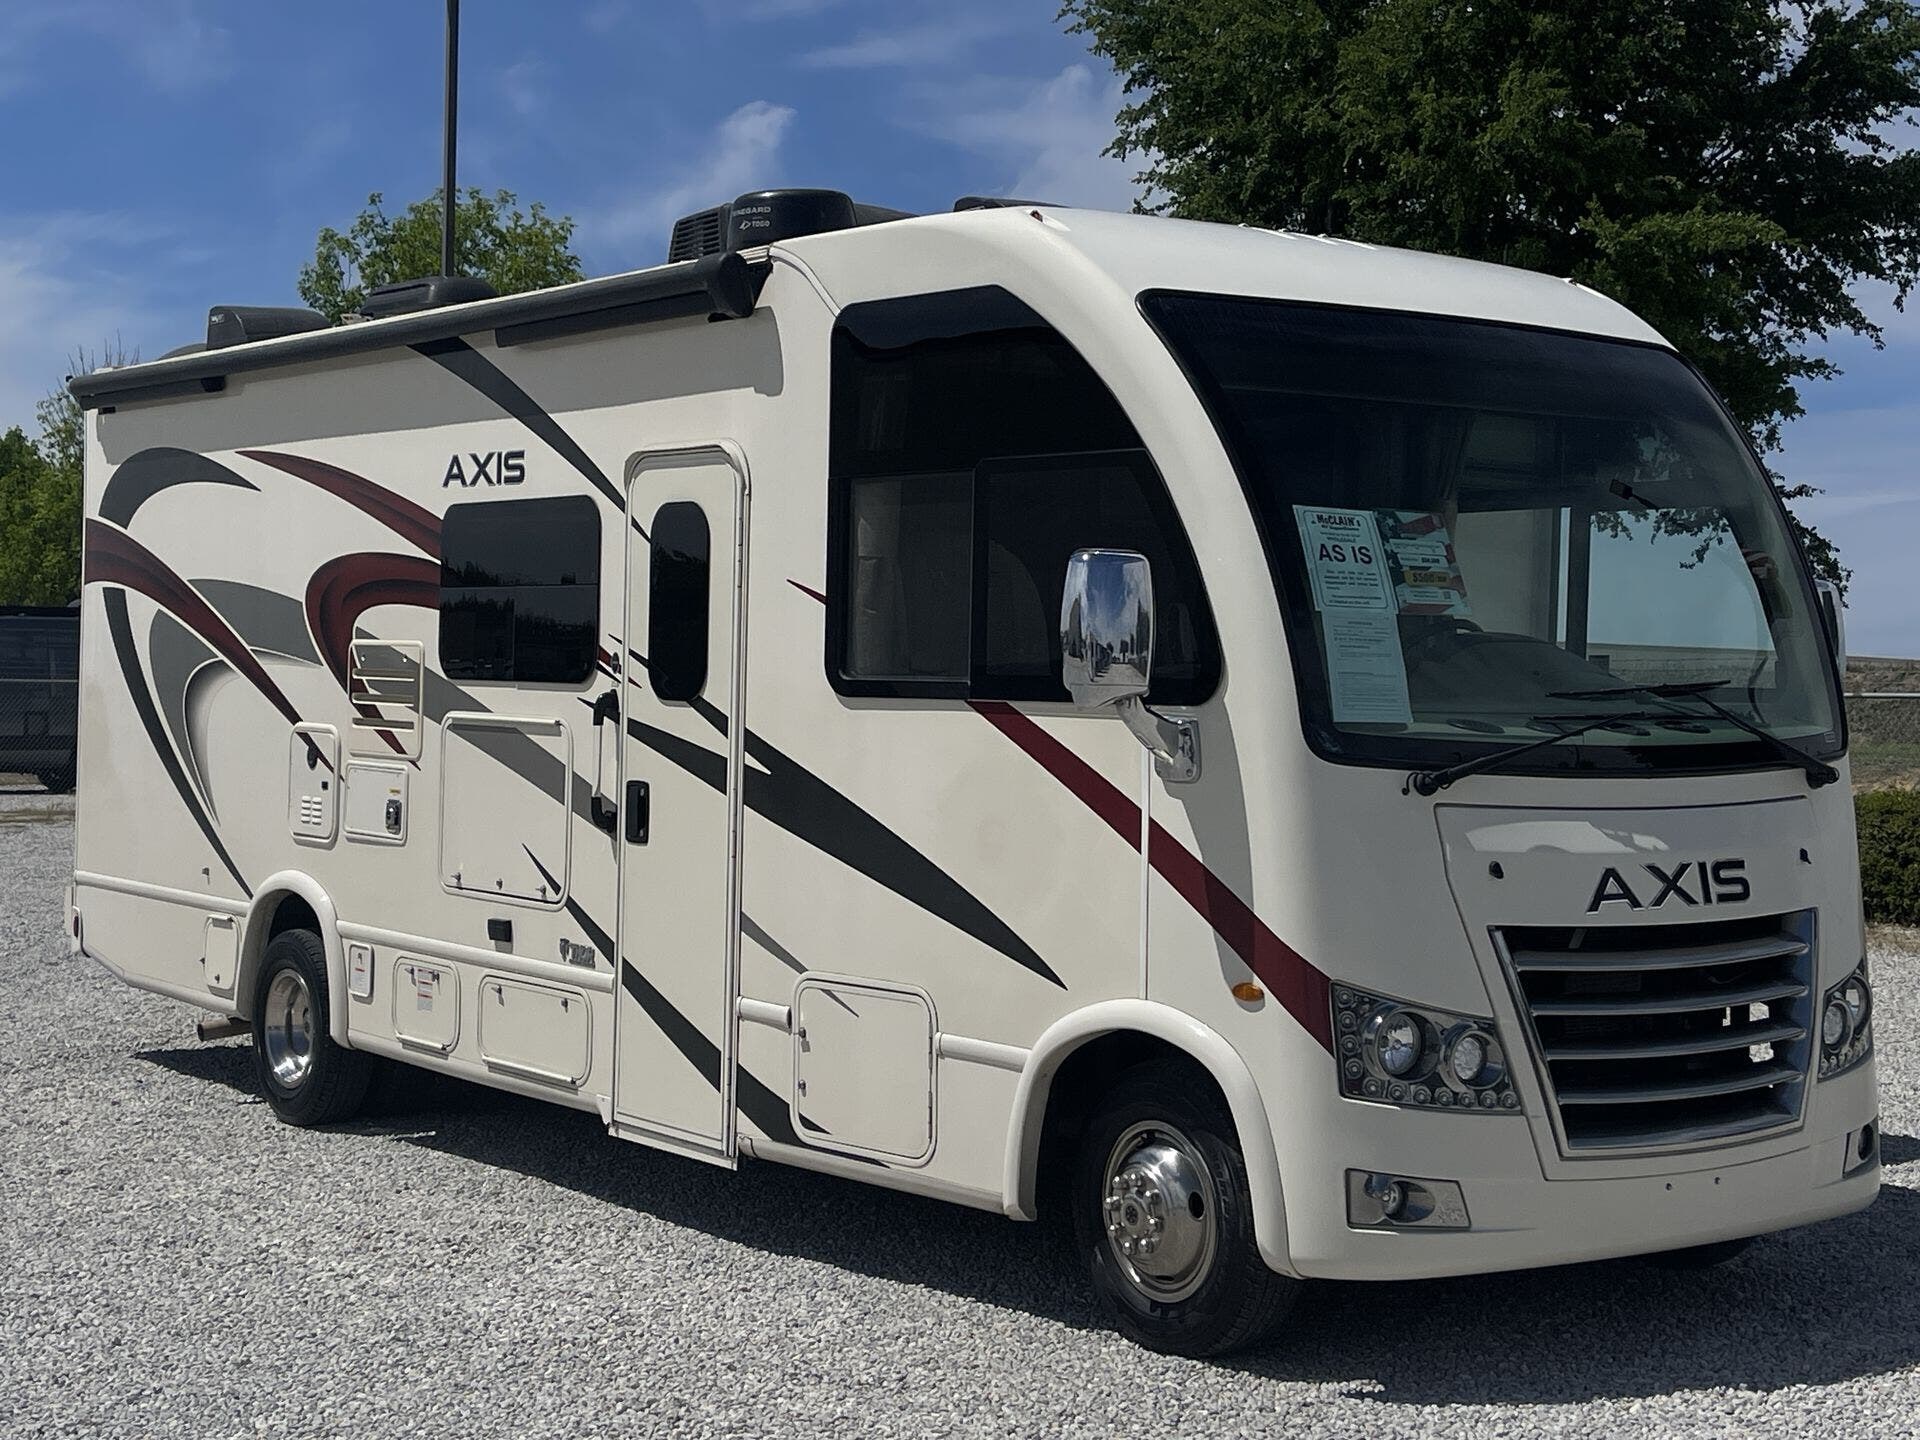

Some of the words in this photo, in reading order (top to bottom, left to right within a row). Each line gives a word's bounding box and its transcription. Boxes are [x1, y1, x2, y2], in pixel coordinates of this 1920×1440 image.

[442, 450, 525, 487] AXIS
[1319, 543, 1346, 562] AS
[1351, 545, 1372, 564] IS
[1586, 858, 1750, 914] AXIS
